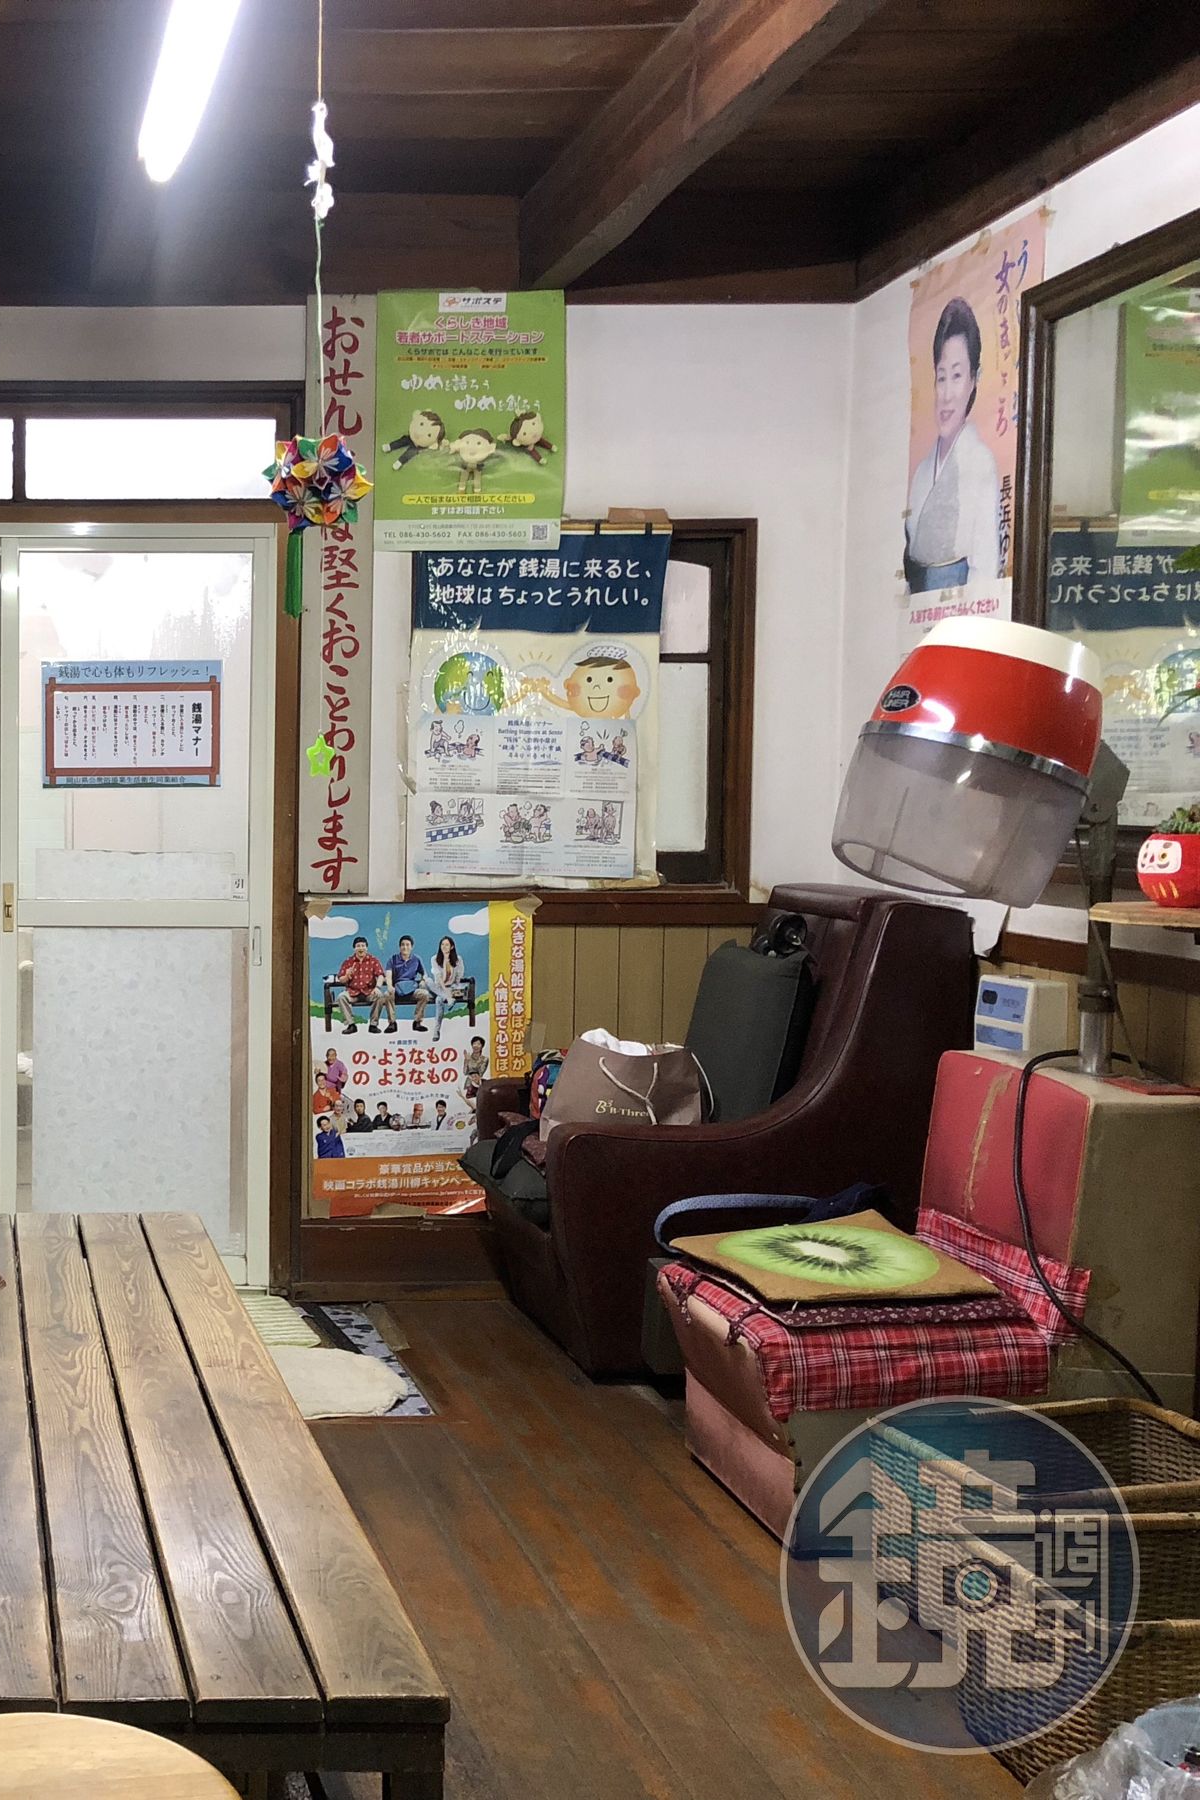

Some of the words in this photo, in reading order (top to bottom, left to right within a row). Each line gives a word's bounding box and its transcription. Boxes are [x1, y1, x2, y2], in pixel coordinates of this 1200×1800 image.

[462, 297, 502, 305] サポステ
[434, 316, 509, 331] くらしき地域
[396, 331, 544, 345] 若者サポートステーション
[191, 702, 202, 757] 銭湯マナー
